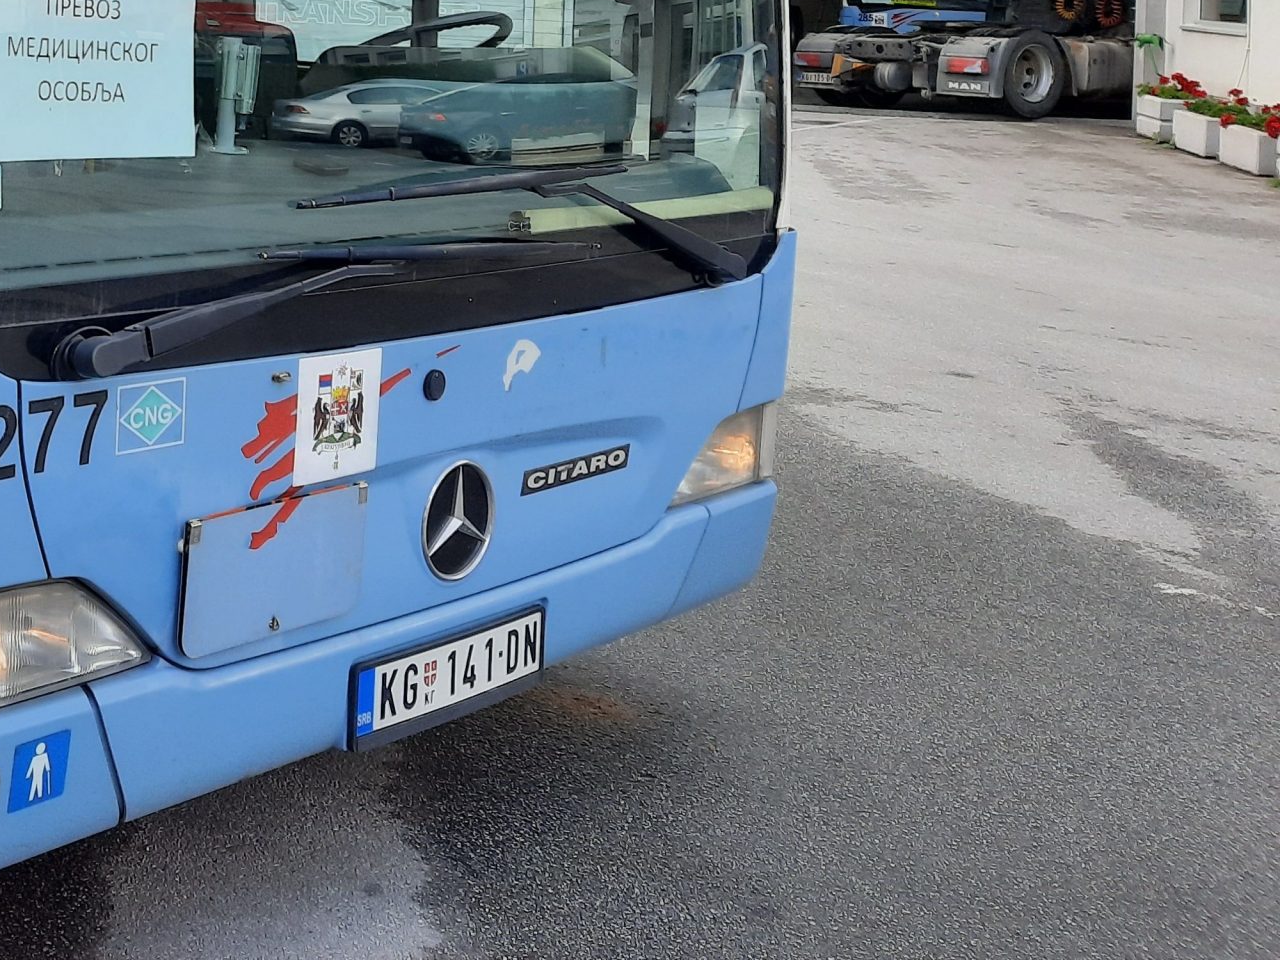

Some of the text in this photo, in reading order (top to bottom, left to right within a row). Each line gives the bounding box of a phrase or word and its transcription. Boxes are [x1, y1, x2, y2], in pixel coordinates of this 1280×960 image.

[858, 13, 874, 22] 285
[6, 36, 159, 64] МЕДИЦИНСКОГ
[38, 80, 126, 103] ОСОБЉА
[948, 81, 982, 91] MAN
[129, 403, 174, 429] CNG
[527, 449, 626, 489] CITARO
[379, 663, 419, 721] KG
[357, 711, 372, 727] SRB
